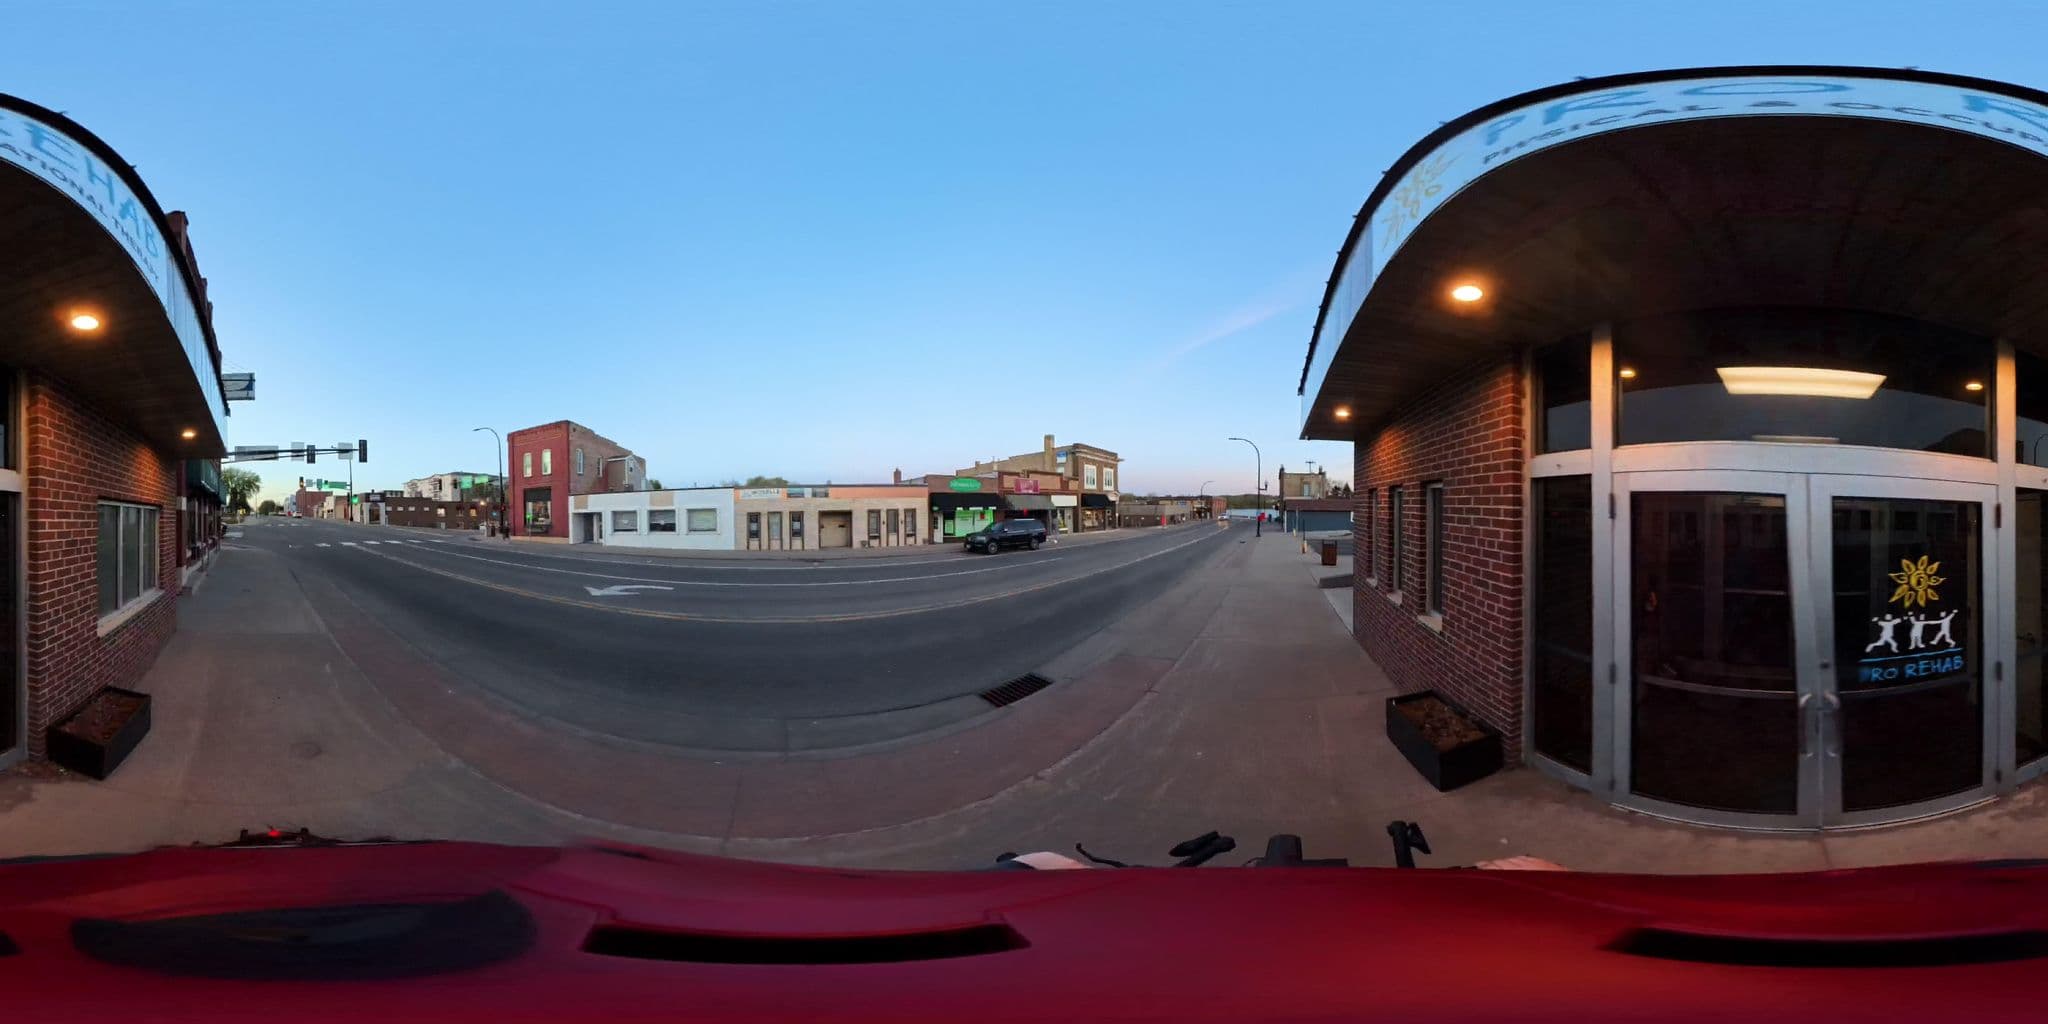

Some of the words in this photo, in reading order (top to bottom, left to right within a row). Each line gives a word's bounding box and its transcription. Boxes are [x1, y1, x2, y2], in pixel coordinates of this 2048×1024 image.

[1484, 81, 1855, 146] PRO
[1826, 101, 2048, 147] OCCUP
[0, 117, 159, 258] EHAB
[1904, 655, 1964, 678] REHAB
